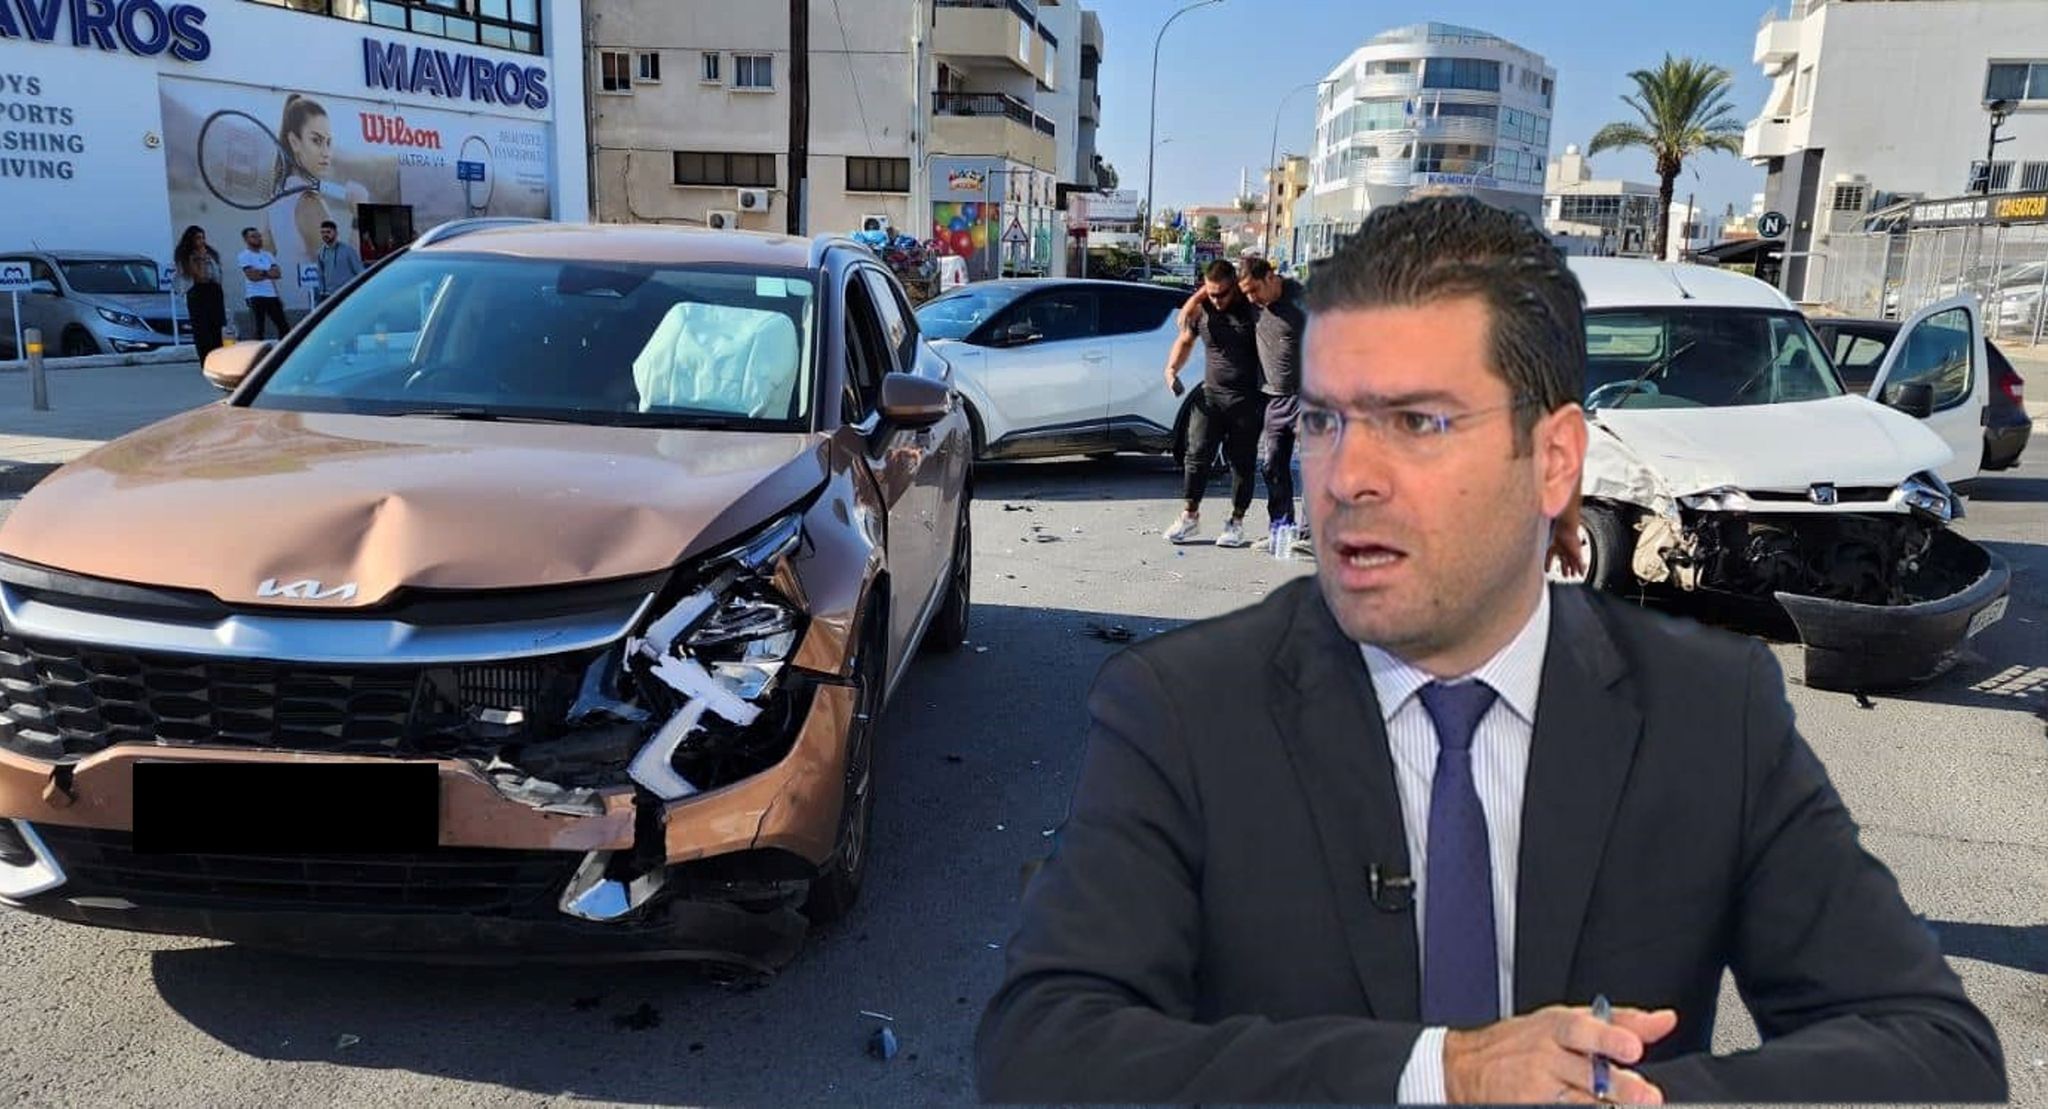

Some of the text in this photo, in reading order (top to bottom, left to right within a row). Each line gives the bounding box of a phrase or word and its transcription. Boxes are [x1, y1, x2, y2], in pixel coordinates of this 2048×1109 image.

[363, 37, 549, 110] MAVROS
[0, 130, 84, 154] SHING
[360, 112, 443, 150] Wilson
[1765, 218, 1780, 233] N
